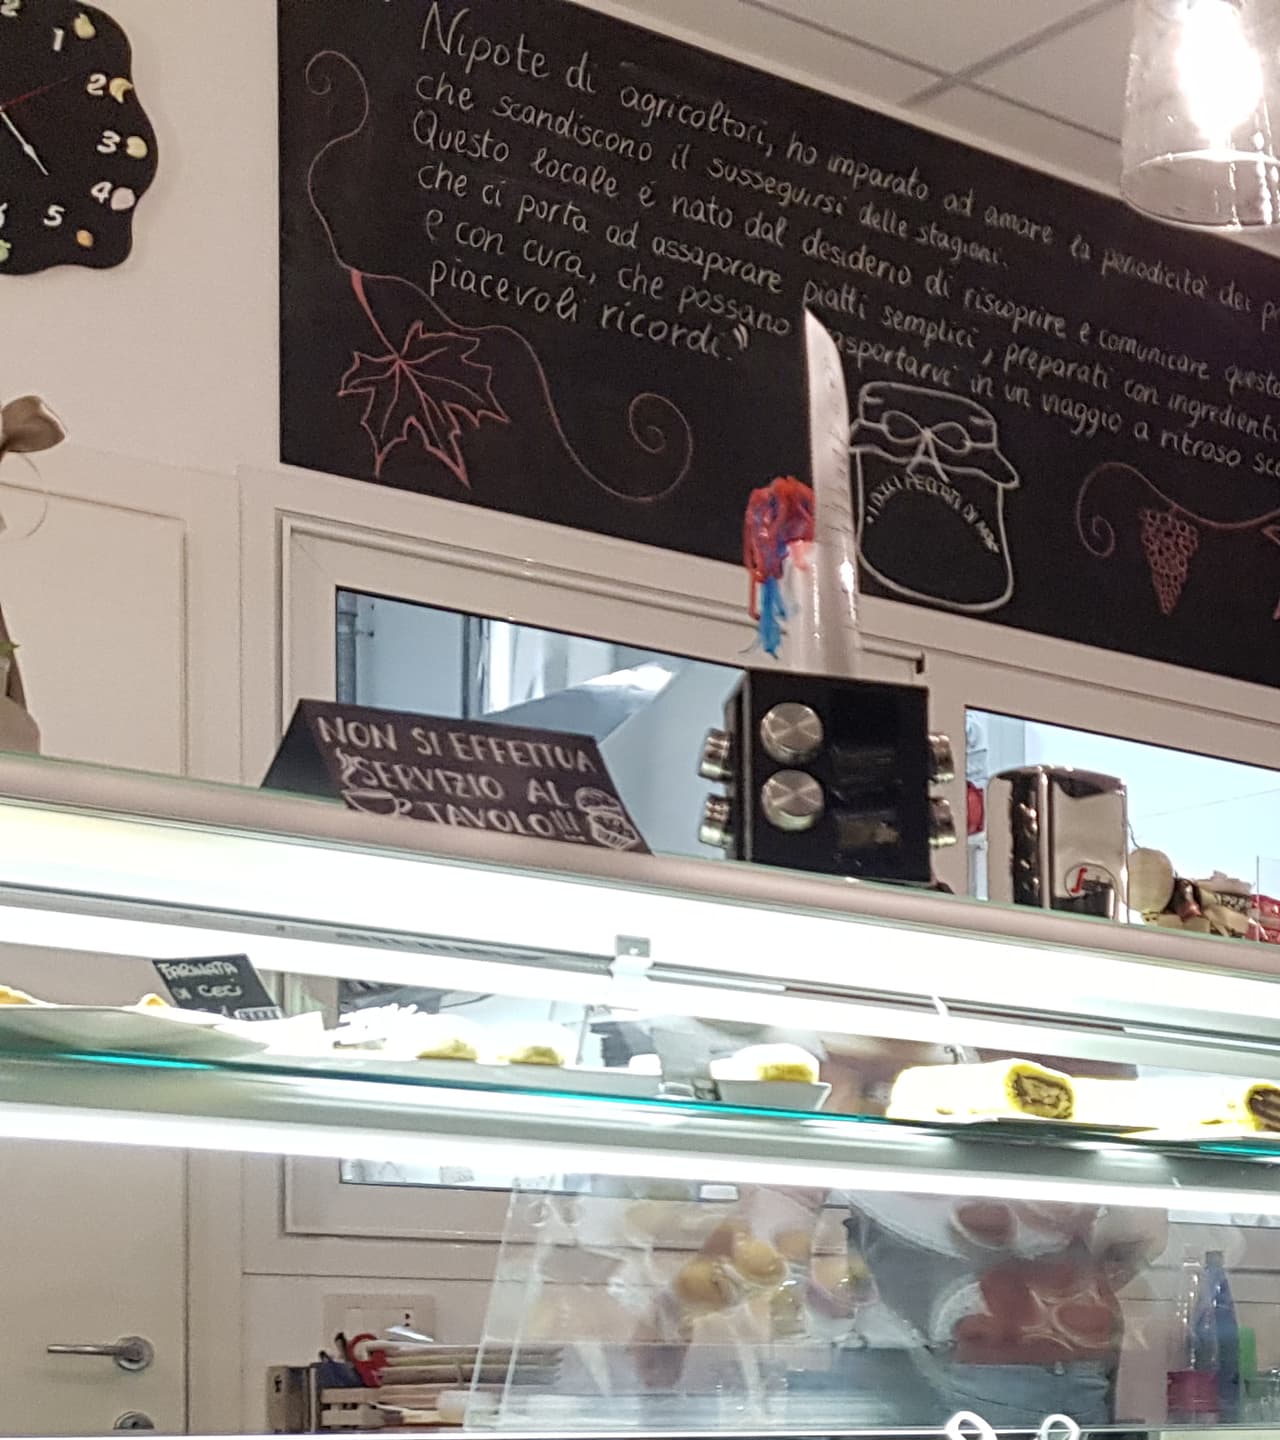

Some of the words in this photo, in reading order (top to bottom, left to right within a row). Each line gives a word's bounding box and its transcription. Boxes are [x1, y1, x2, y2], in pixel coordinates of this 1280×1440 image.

[53, 27, 65, 51] 1
[87, 73, 107, 96] 2
[97, 130, 121, 153] 3
[415, 72, 474, 110] che
[492, 95, 652, 161] scandiscono
[672, 144, 691, 170] il
[707, 157, 848, 215] susseguirsi
[859, 201, 908, 238] delle
[420, 1, 550, 77] Nipote
[566, 51, 597, 94] di
[620, 86, 772, 157] agricoltori,
[786, 131, 818, 165] ho
[828, 154, 929, 200] imparato
[943, 188, 973, 216] ad
[985, 206, 1054, 244] amare
[1069, 233, 1091, 261] la
[1219, 280, 1252, 312] dei
[43, 204, 65, 227] 5
[90, 181, 112, 203] 4
[413, 110, 510, 161] Questo
[531, 148, 619, 197] locale
[672, 195, 734, 228] nato
[745, 211, 789, 247] dal
[802, 228, 912, 286] desiderio
[925, 269, 953, 297] di
[964, 288, 1067, 338] riscoprire
[1079, 322, 1092, 343] e
[1100, 329, 1209, 381] comunicare
[418, 161, 468, 197] che
[482, 180, 507, 206] ci
[517, 195, 590, 232] porta
[606, 222, 637, 249] ad
[652, 235, 783, 294] assaporare
[803, 279, 868, 320] piatti
[1003, 342, 1114, 390] preparati
[1124, 378, 1159, 406] con
[430, 257, 582, 322] piacevoli
[426, 209, 444, 241] e
[455, 220, 505, 256] con
[523, 239, 597, 285] cura,
[618, 265, 665, 298] che
[678, 284, 791, 335] possano
[970, 374, 993, 397] in
[1005, 386, 1030, 408] un
[1043, 391, 1122, 437] viaggio
[1134, 420, 1149, 440] a
[316, 716, 398, 751] NON
[411, 726, 442, 756] SI
[449, 732, 598, 773] EFFETTUA
[352, 755, 504, 800] SERVIZIO
[528, 777, 570, 809] AL
